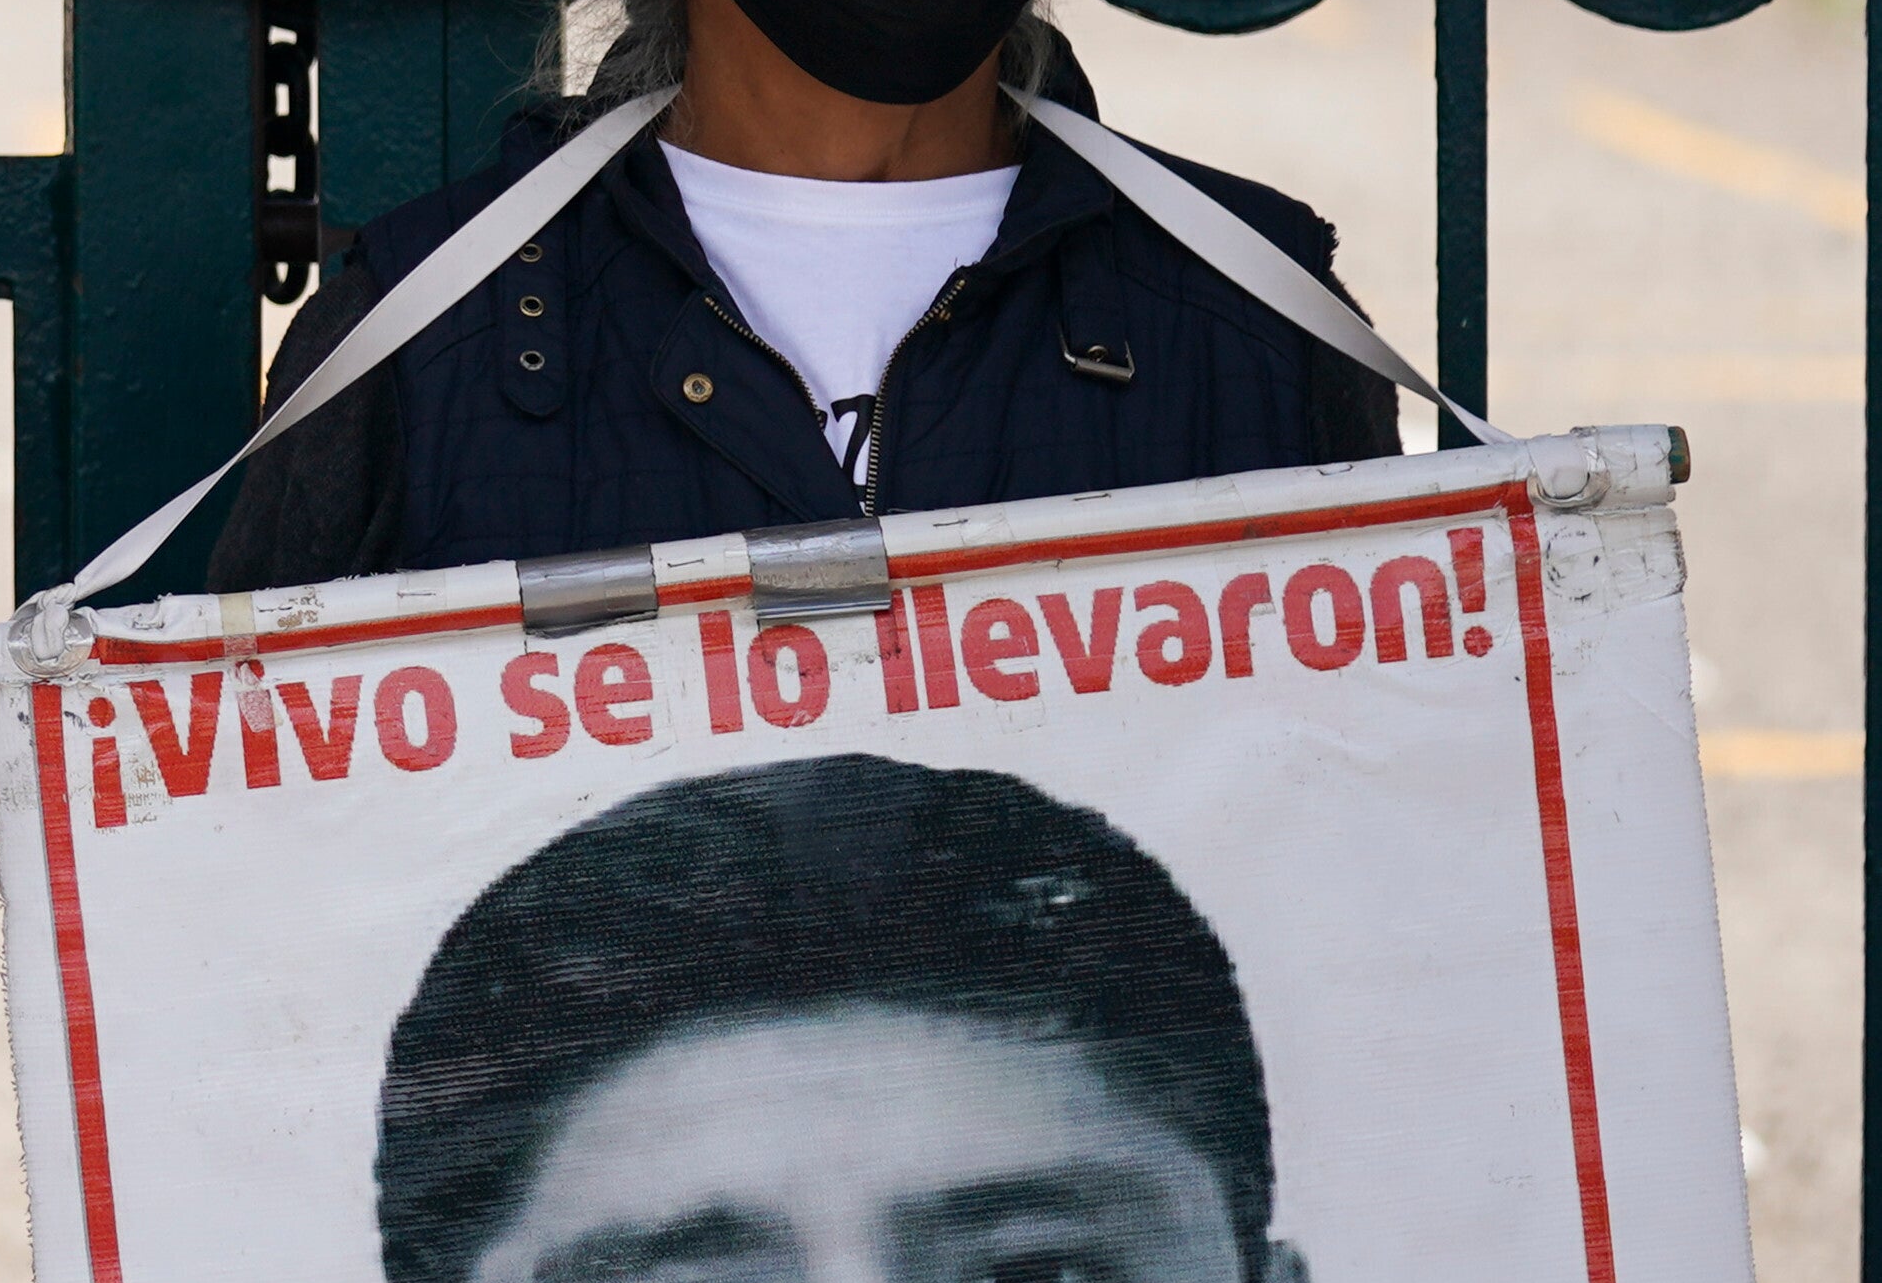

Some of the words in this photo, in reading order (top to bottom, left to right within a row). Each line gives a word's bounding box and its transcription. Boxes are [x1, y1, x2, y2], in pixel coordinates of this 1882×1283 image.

[87, 658, 457, 828] ¡Vivo
[500, 641, 655, 758] se
[699, 609, 831, 735] lo
[873, 526, 1494, 714] llevaron!
